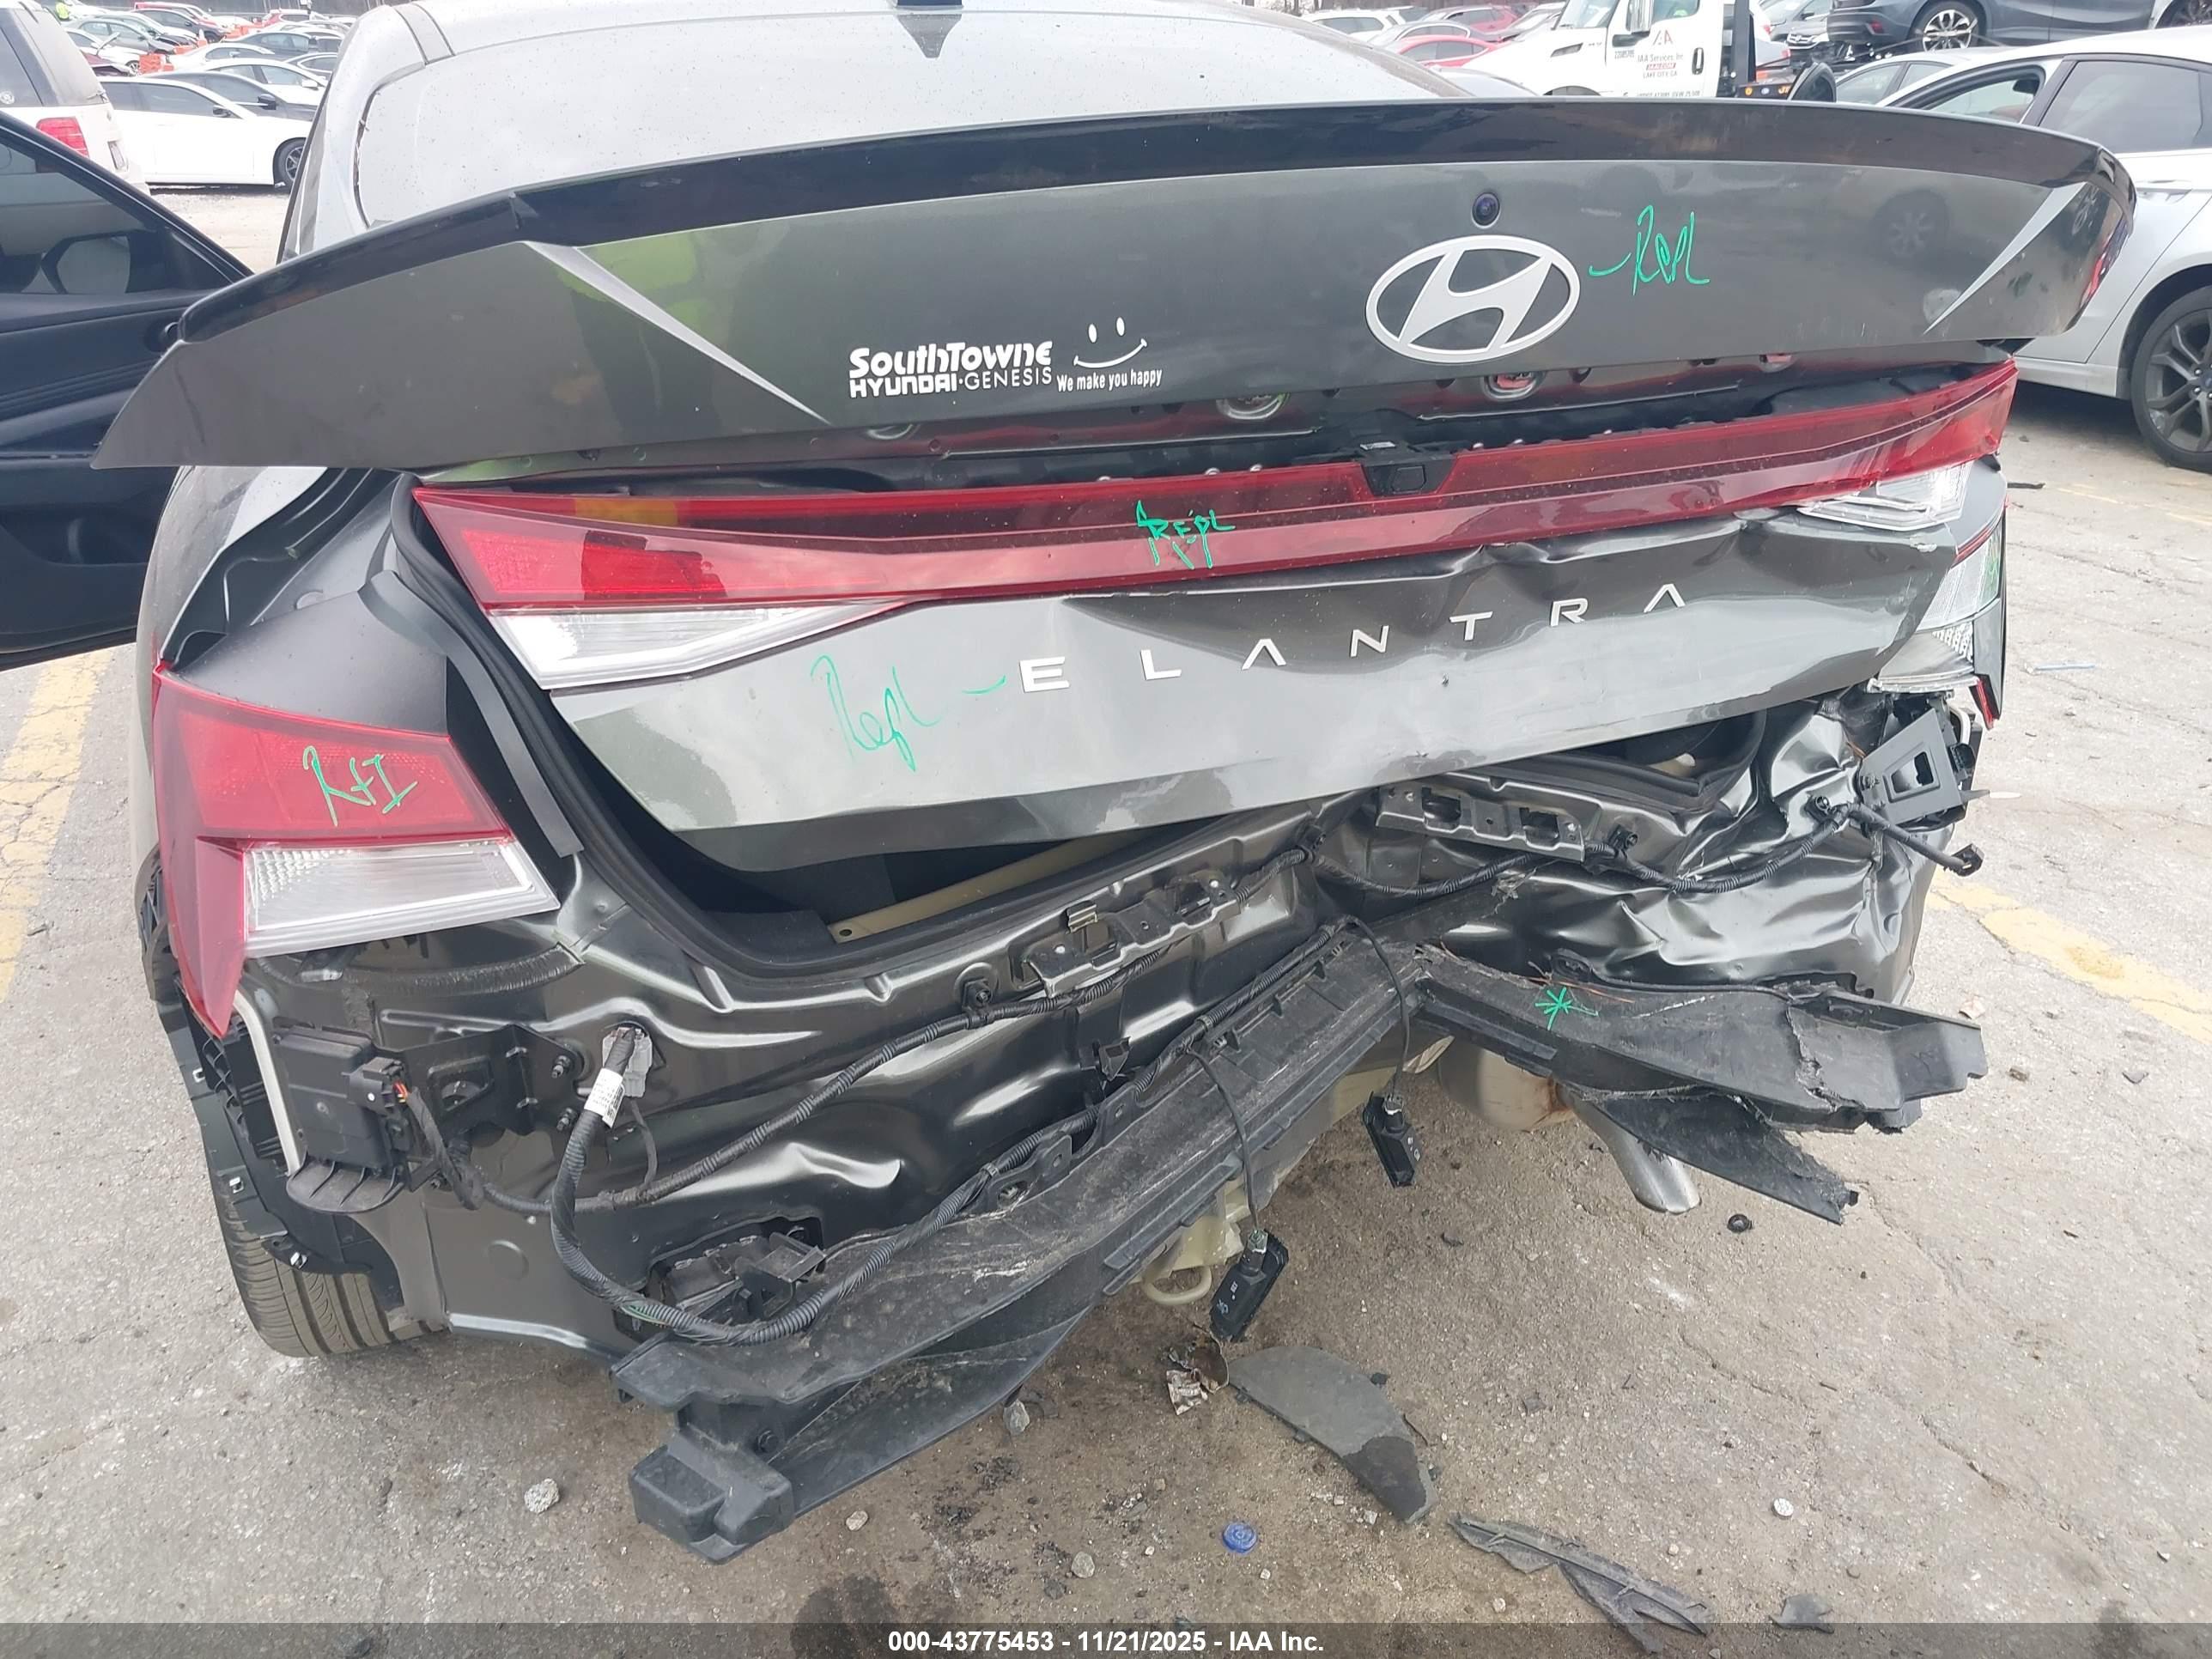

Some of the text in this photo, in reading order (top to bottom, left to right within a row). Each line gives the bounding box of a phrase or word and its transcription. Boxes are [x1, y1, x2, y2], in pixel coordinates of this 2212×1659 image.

[1056, 368, 1163, 392] We make you happy
[1019, 583, 1686, 692] ELANTRA
